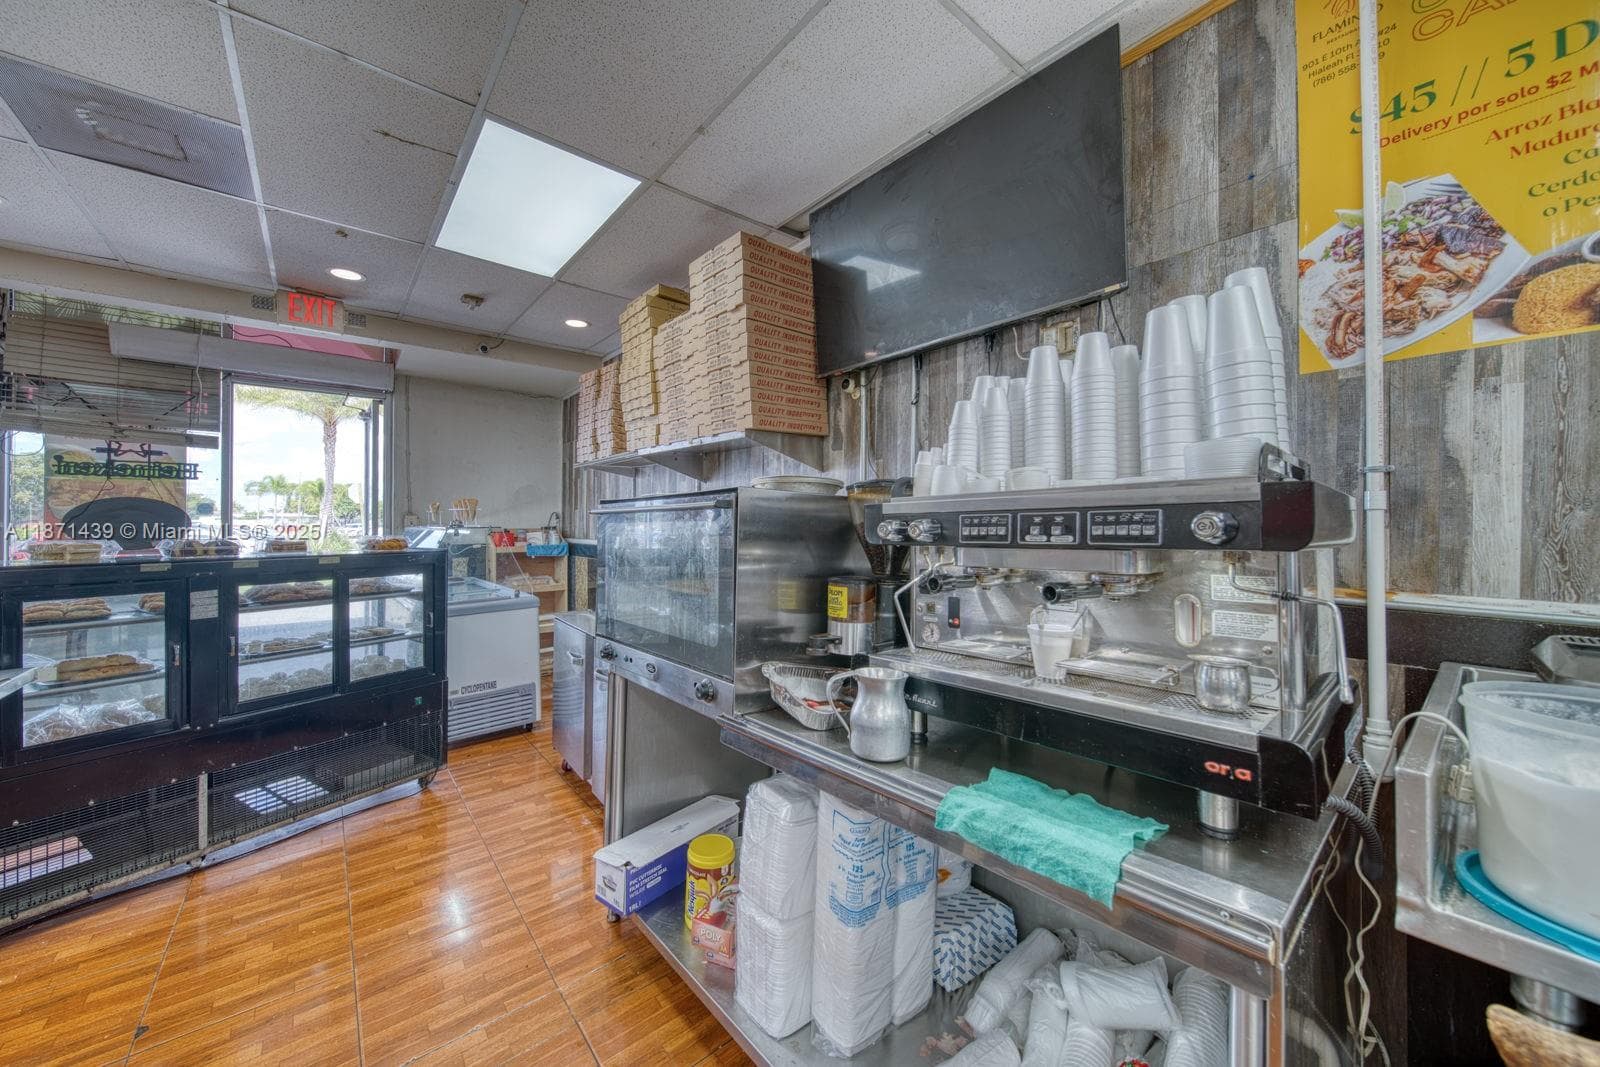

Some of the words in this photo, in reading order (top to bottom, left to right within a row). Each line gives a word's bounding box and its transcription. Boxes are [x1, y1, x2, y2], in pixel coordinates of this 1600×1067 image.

[1302, 58, 1320, 71] 901
[1322, 53, 1329, 62] E
[1330, 43, 1353, 58] 10th
[1504, 39, 1536, 78] 5
[1308, 58, 1343, 79] Hialeah
[1313, 71, 1336, 89] (786)
[1380, 116, 1453, 149] Delivery
[1458, 101, 1491, 125] por
[1496, 84, 1540, 107] solo
[1546, 69, 1573, 90] $2
[1485, 113, 1553, 145] Arroz
[1542, 206, 1558, 217] o
[748, 238, 776, 254] QUALITY
[749, 251, 777, 266] QUALITY
[750, 265, 778, 280] QUALITY
[749, 281, 777, 295] QUALITY
[750, 294, 778, 309] QUALITY
[287, 291, 337, 328] EXIT
[756, 365, 783, 377] QUALITY
[756, 379, 783, 390] QUALITY
[757, 392, 784, 402] QUALITY
[758, 405, 785, 415] QUALITY
[759, 418, 786, 428] QUALITY
[687, 880, 697, 916] Nesquik
